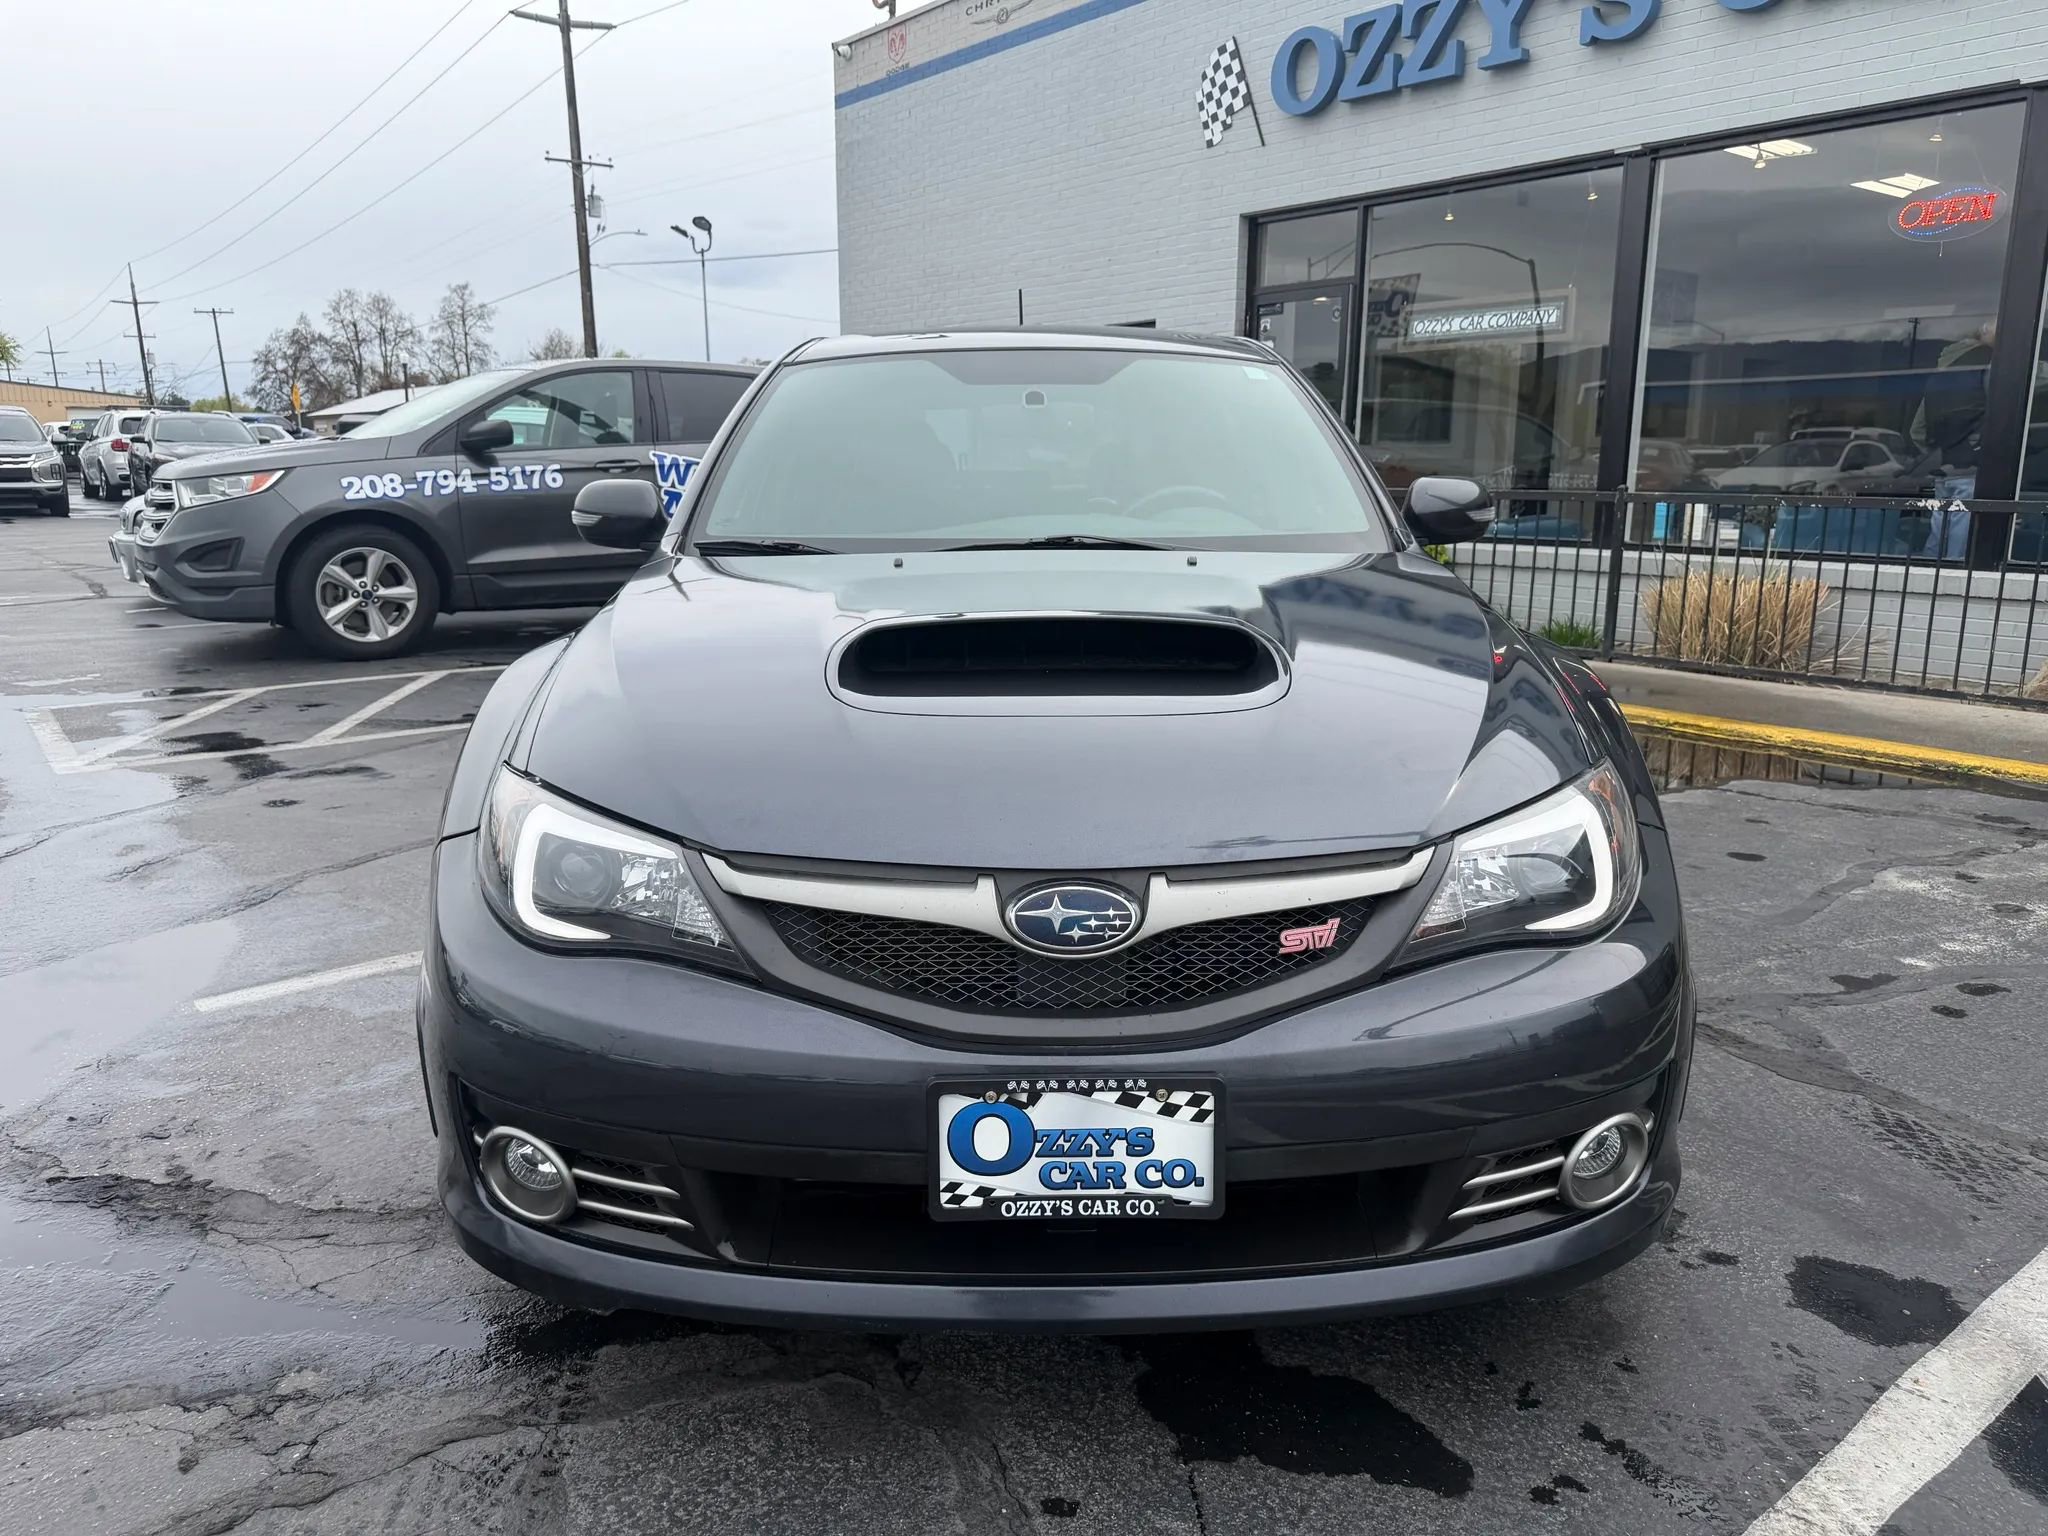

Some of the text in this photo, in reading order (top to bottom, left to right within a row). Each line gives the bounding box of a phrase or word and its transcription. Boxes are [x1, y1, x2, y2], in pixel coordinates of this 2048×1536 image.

[1270, 0, 1662, 116] OZZYS
[1898, 192, 1997, 229] OPEN
[1459, 315, 1483, 330] CAR
[1488, 309, 1556, 328] COMPANY
[340, 464, 564, 500] 208-794-5176
[1038, 1158, 1204, 1190] CAR CO.
[1001, 1199, 1160, 1217] OZZY'S CAR CO.
